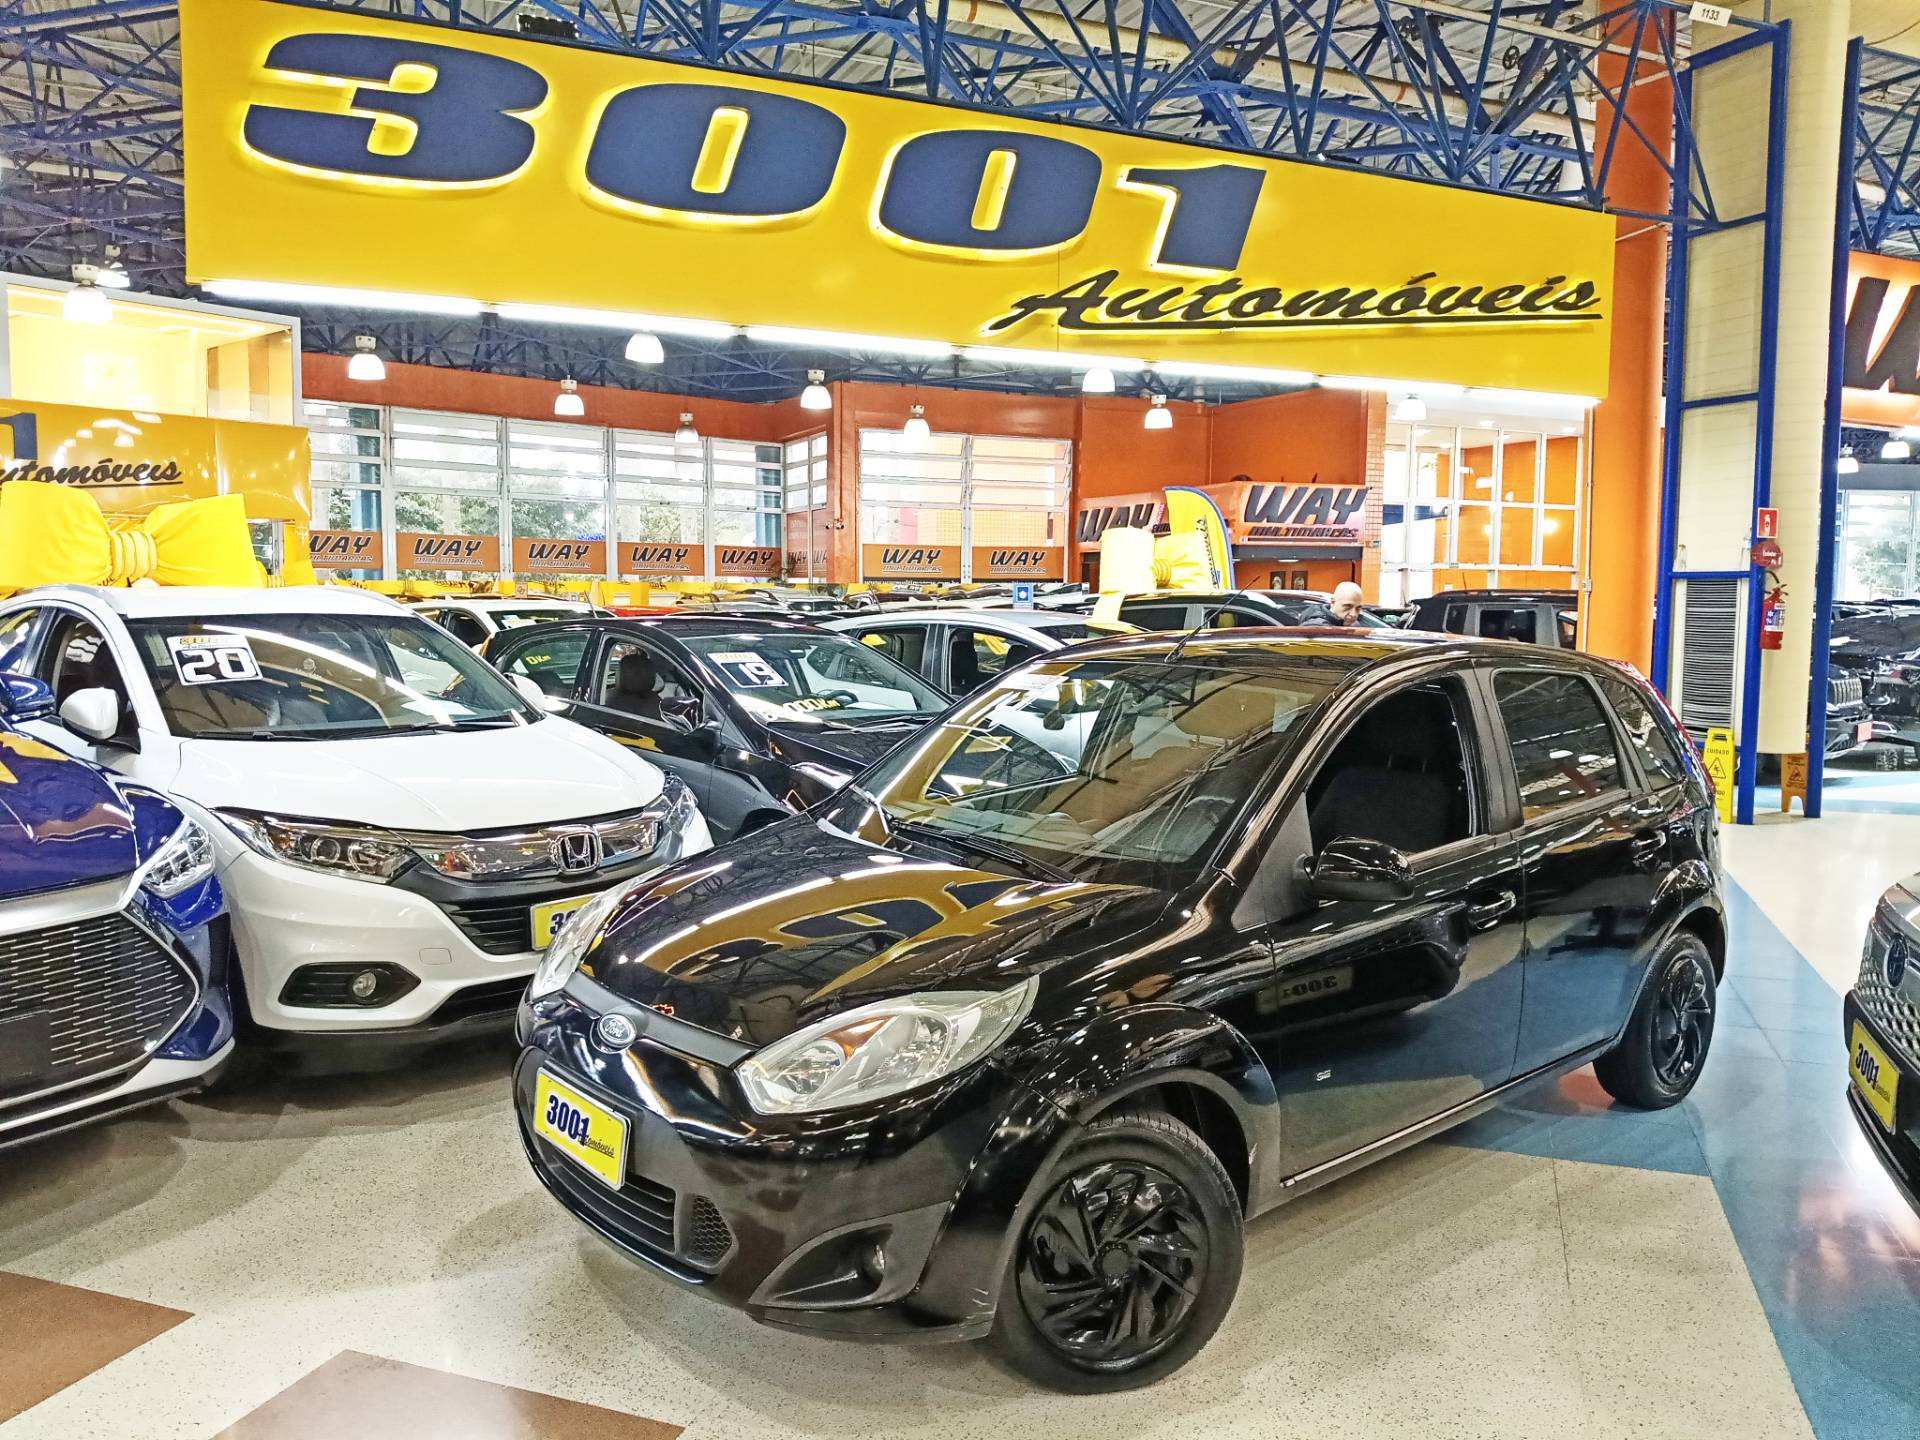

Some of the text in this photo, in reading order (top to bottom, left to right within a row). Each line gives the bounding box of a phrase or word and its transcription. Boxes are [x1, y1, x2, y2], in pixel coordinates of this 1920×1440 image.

[1702, 7, 1720, 20] 1133
[242, 32, 1266, 271] 3001
[987, 268, 1603, 332] Automóveis
[0, 458, 183, 489] utomóveis
[1244, 485, 1369, 525] WAY
[1076, 503, 1155, 543] WAY
[1248, 526, 1359, 538] MULTIMARCAS
[413, 538, 483, 557] WAY
[528, 543, 591, 560] WAY
[631, 547, 689, 562] WAY
[721, 549, 774, 564] WAY
[882, 548, 942, 564] WAY
[990, 550, 1046, 566] WAY
[181, 649, 257, 682] 20
[738, 662, 783, 686] 19
[605, 1021, 625, 1039] Ford
[1856, 1042, 1880, 1090] 3001
[546, 1094, 590, 1147] 3001
